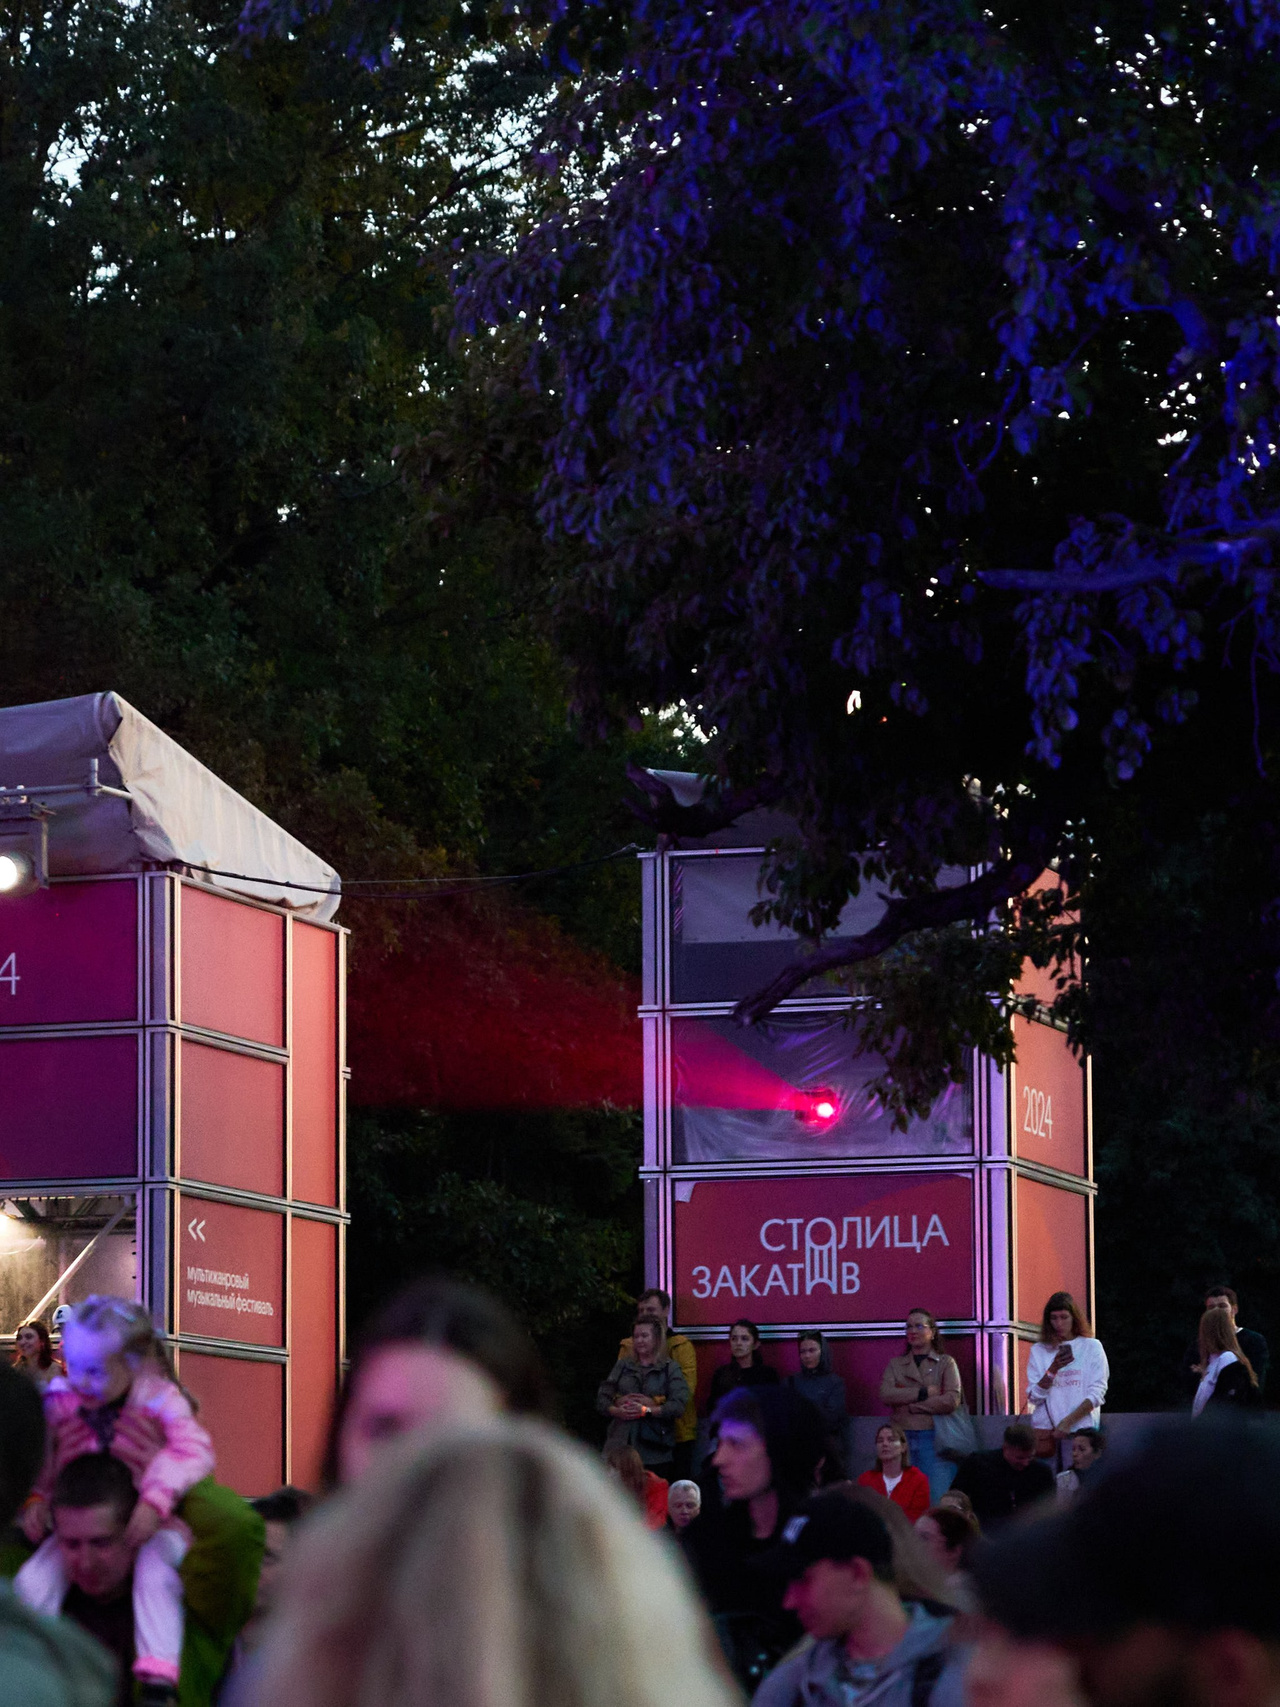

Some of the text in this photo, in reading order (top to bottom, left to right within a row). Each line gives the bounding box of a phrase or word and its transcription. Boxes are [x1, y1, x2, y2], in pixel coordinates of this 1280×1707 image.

[1023, 1085, 1053, 1140] 2024
[759, 1213, 950, 1254] СТОЛИЦА
[186, 1288, 274, 1316] музыкальный фестиваль
